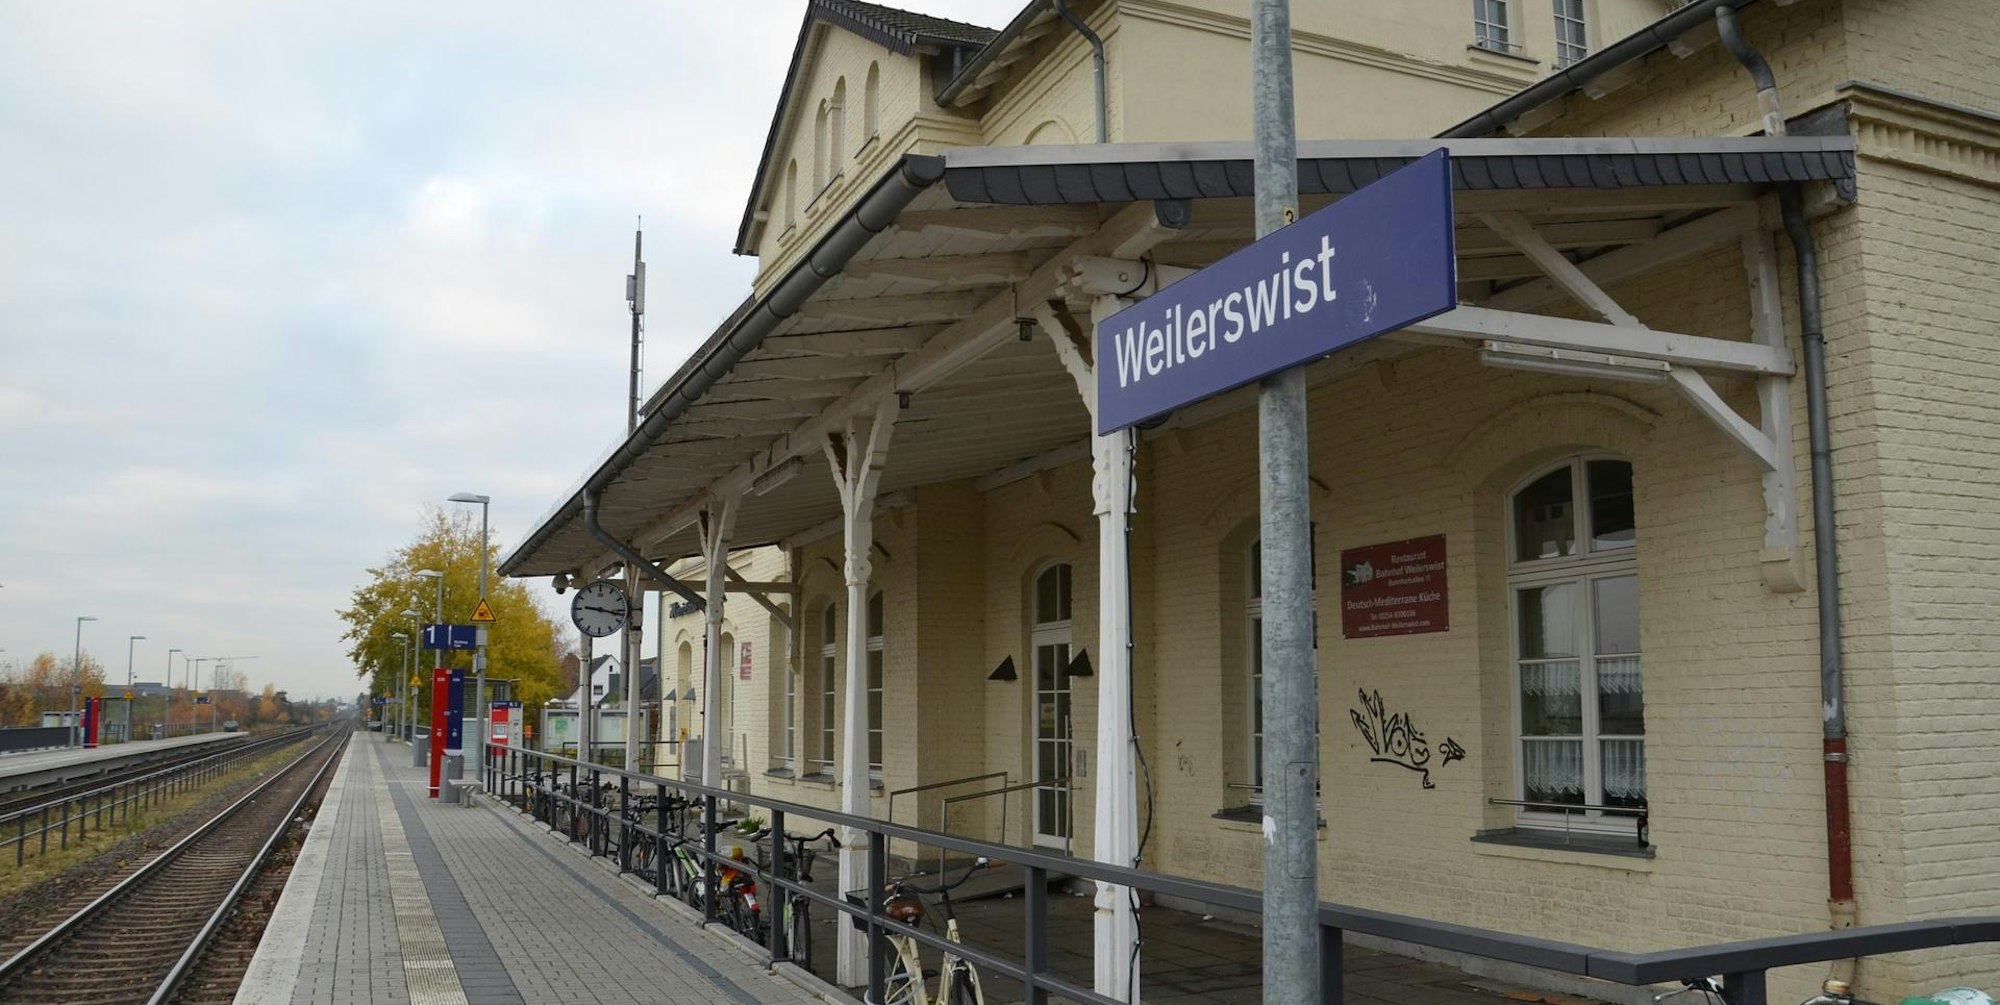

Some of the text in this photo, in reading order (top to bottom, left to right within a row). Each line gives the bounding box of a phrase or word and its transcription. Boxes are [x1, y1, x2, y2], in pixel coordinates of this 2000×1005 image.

[1114, 235, 1337, 389] Weilerswist
[1376, 561, 1445, 578] Bahnhof Weilerswist
[1347, 591, 1440, 610] Deutsch-Mediterrane Küche
[426, 625, 436, 644] 1
